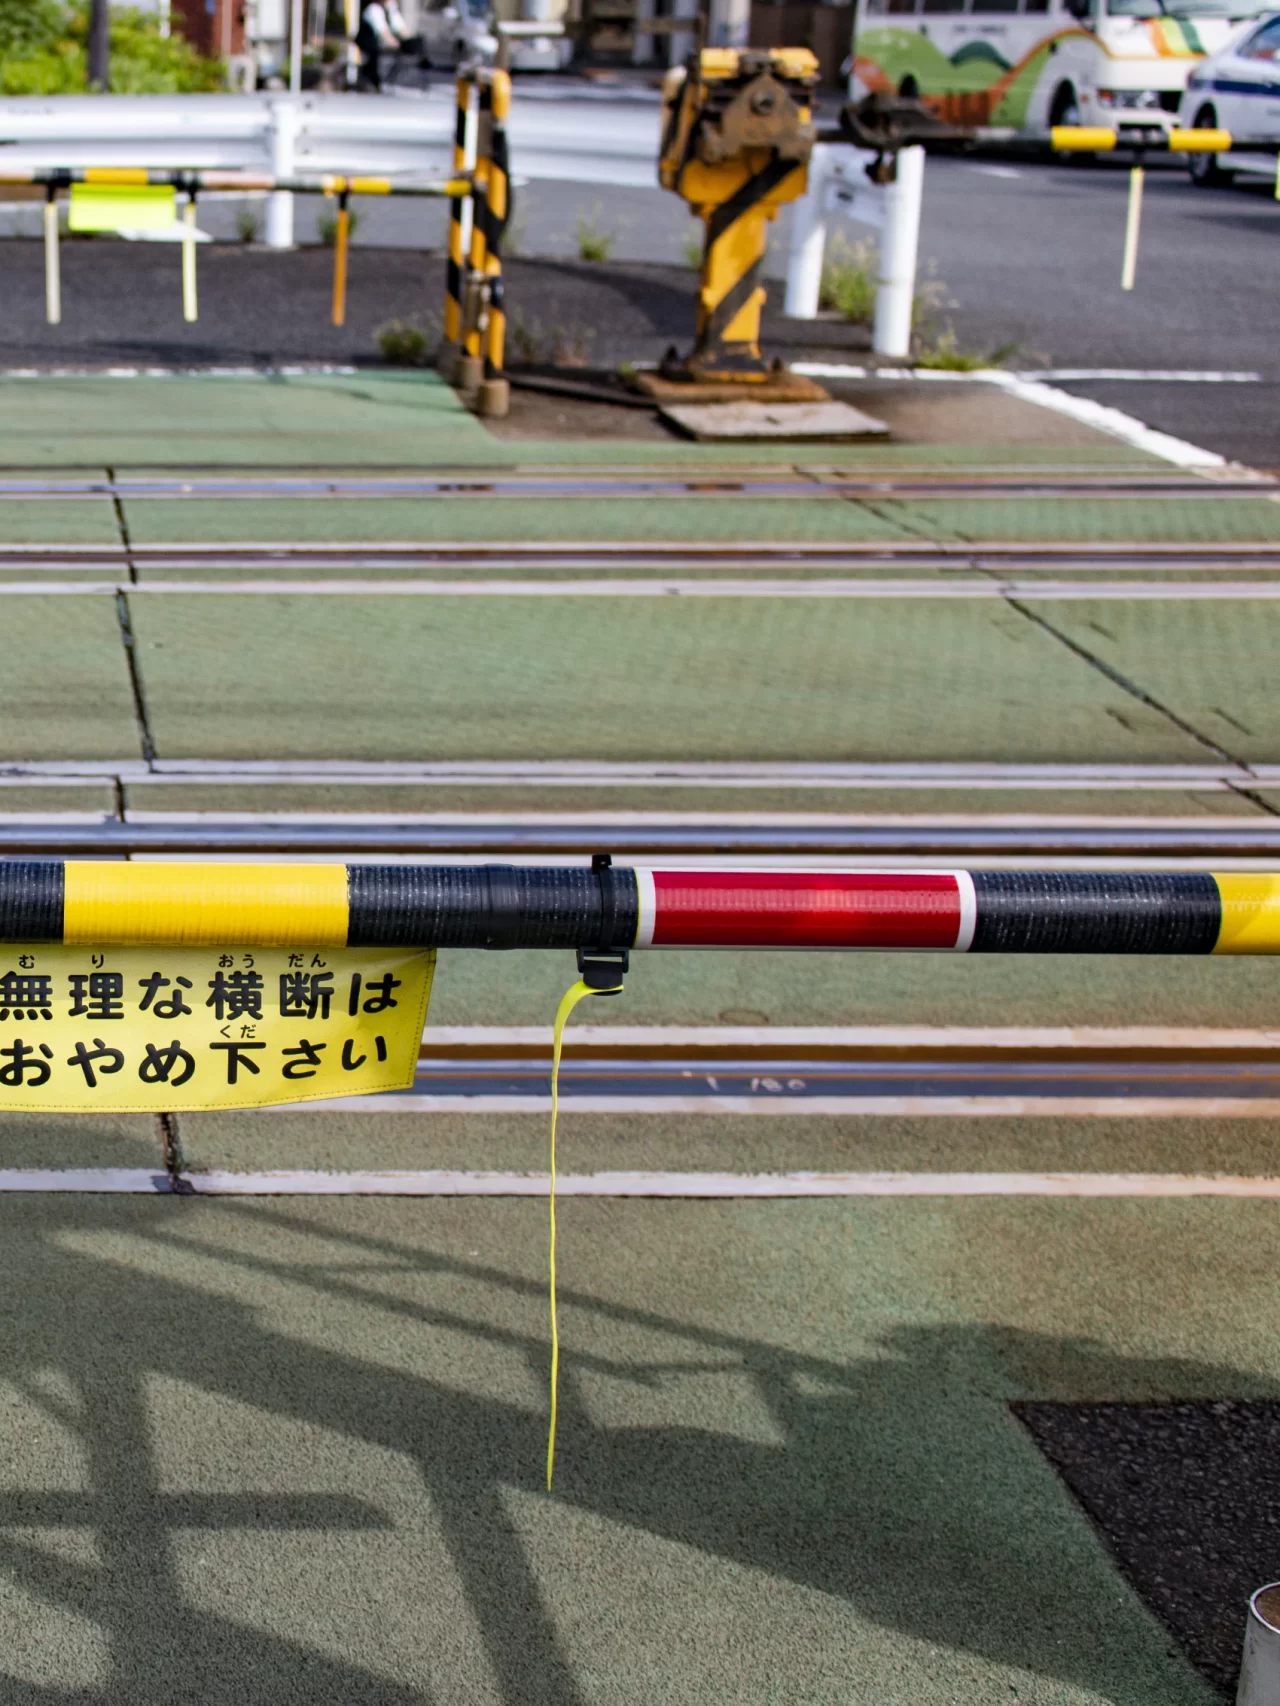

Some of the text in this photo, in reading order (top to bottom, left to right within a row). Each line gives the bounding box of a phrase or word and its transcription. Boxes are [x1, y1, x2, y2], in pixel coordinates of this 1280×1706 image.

[18, 952, 328, 970] む り おう だん
[220, 1023, 257, 1039] くだ
